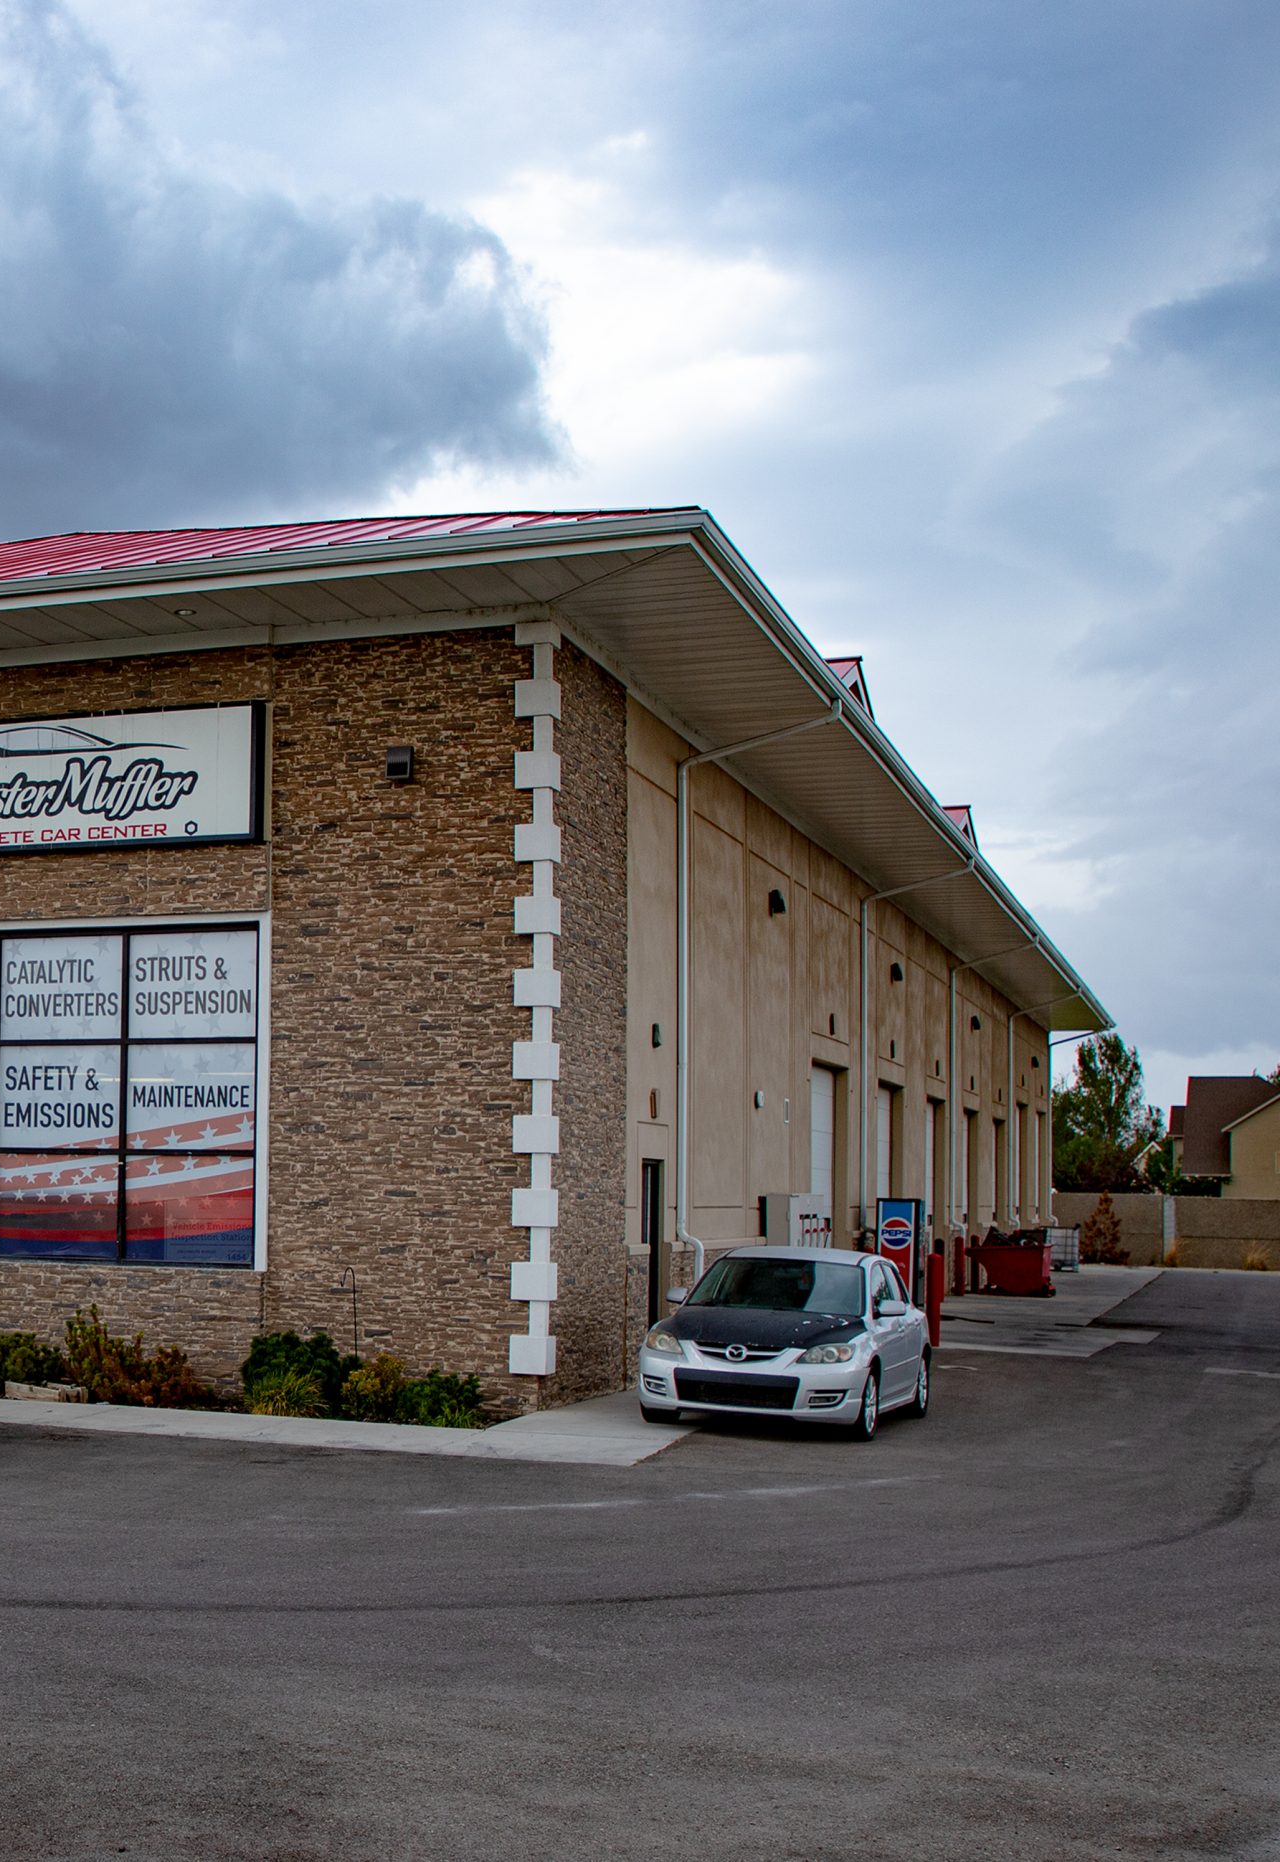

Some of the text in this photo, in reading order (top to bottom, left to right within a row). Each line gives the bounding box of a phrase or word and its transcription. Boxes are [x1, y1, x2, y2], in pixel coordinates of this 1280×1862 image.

[40, 826, 83, 843] CAR
[87, 823, 168, 840] CENTER
[6, 958, 94, 985] CATALYTIC
[135, 955, 228, 982] STRUTS &
[4, 992, 119, 1018] CONVERTERS
[134, 989, 252, 1016] SUSPENSION
[5, 1064, 100, 1091] SAFETY &
[132, 1085, 250, 1108] MAINTENANCE
[3, 1101, 115, 1129] EMISSIONS
[881, 1229, 912, 1238] PEPSI
